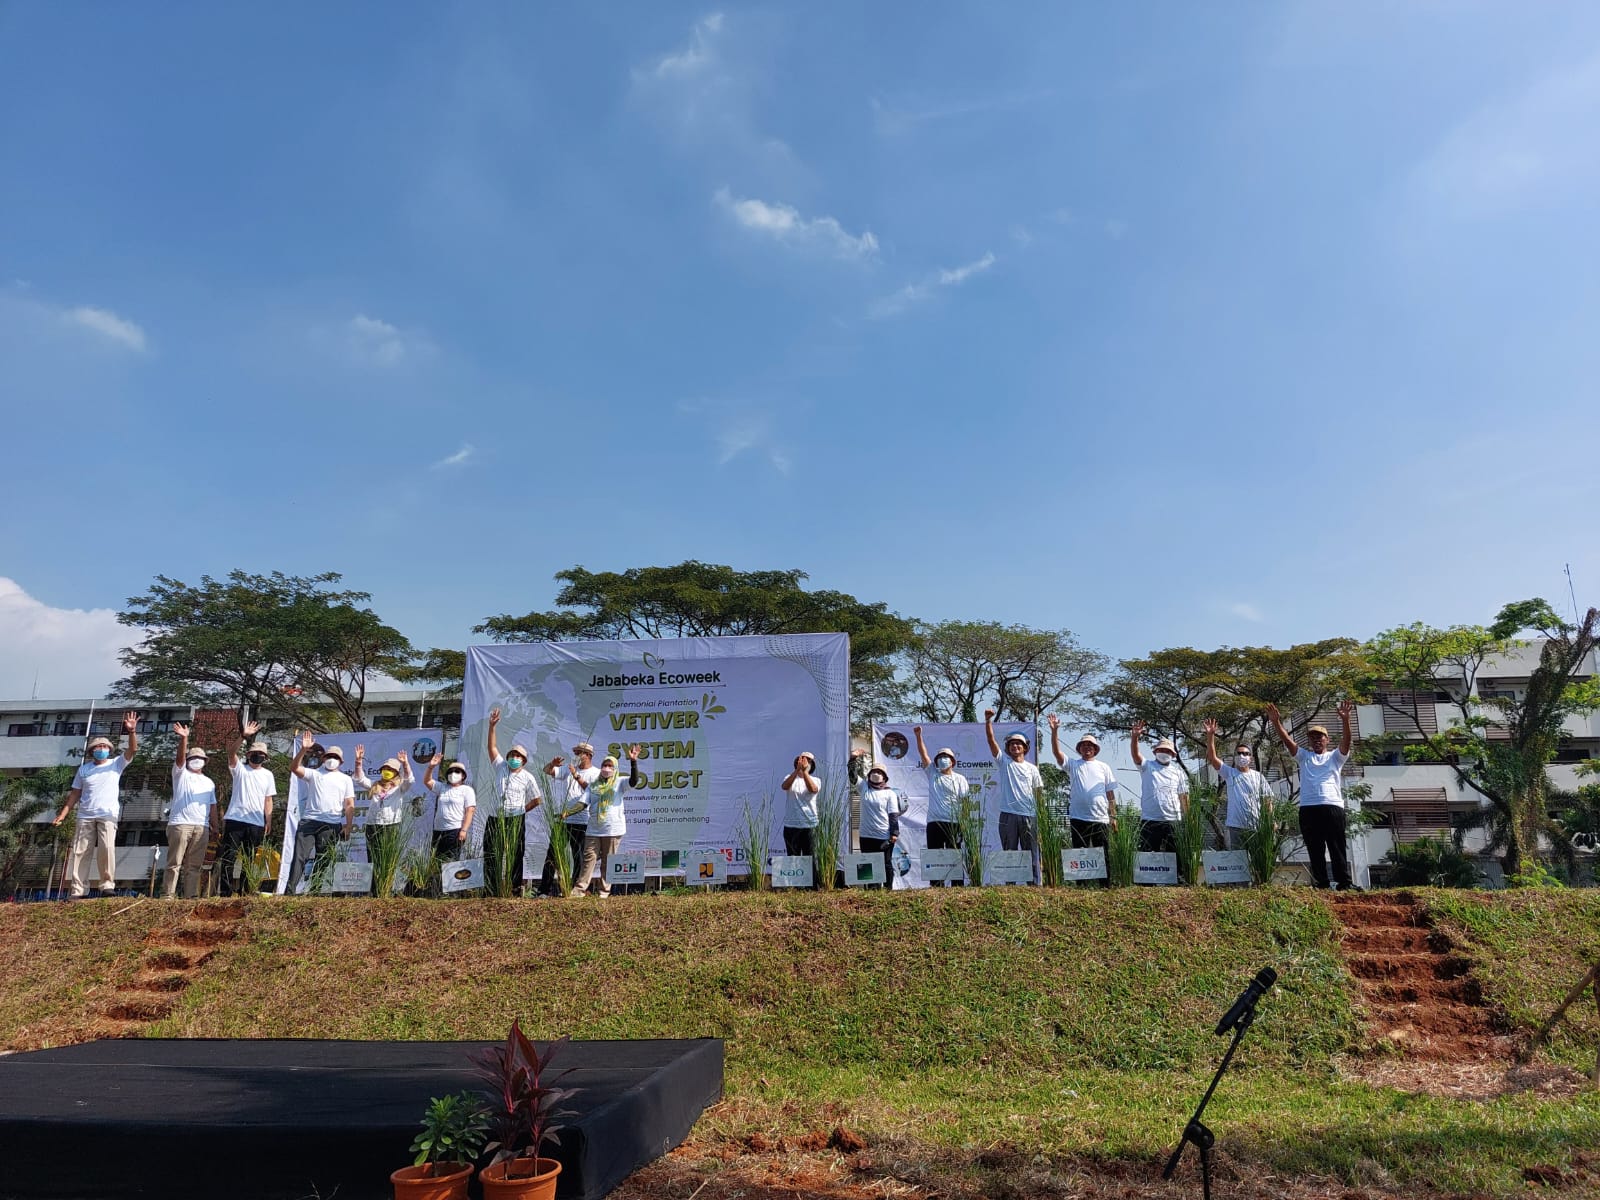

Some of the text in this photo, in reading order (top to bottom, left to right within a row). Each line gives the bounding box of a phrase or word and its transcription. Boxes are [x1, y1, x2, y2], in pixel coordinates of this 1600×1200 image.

[588, 670, 721, 687] Jababeka Ecoweek
[609, 698, 698, 709] Ceremonial Plantation
[609, 710, 700, 731] VETIVER
[607, 740, 695, 760] SYSTEM
[956, 760, 994, 769] Ecoweek
[619, 769, 703, 790] OJECT
[634, 794, 660, 802] Industry
[633, 816, 658, 825] Sungai
[1079, 859, 1098, 870] BNI
